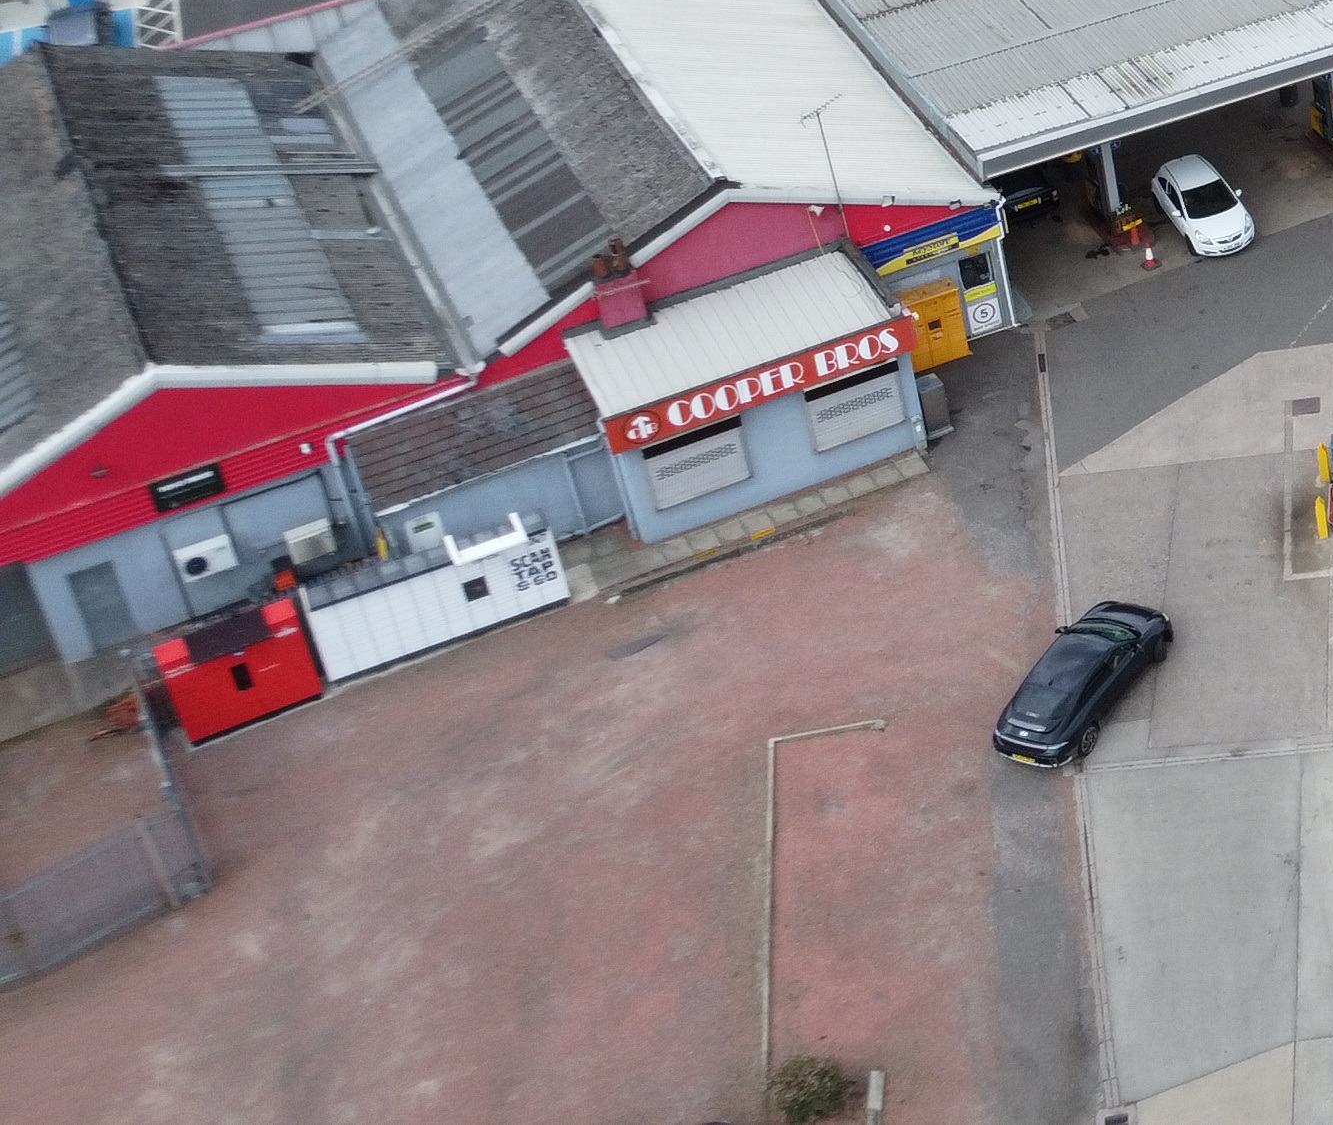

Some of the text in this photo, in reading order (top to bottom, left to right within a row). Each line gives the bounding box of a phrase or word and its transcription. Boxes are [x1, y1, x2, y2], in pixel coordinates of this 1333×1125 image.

[980, 308, 989, 318] 5
[667, 327, 899, 426] COOPER BROS
